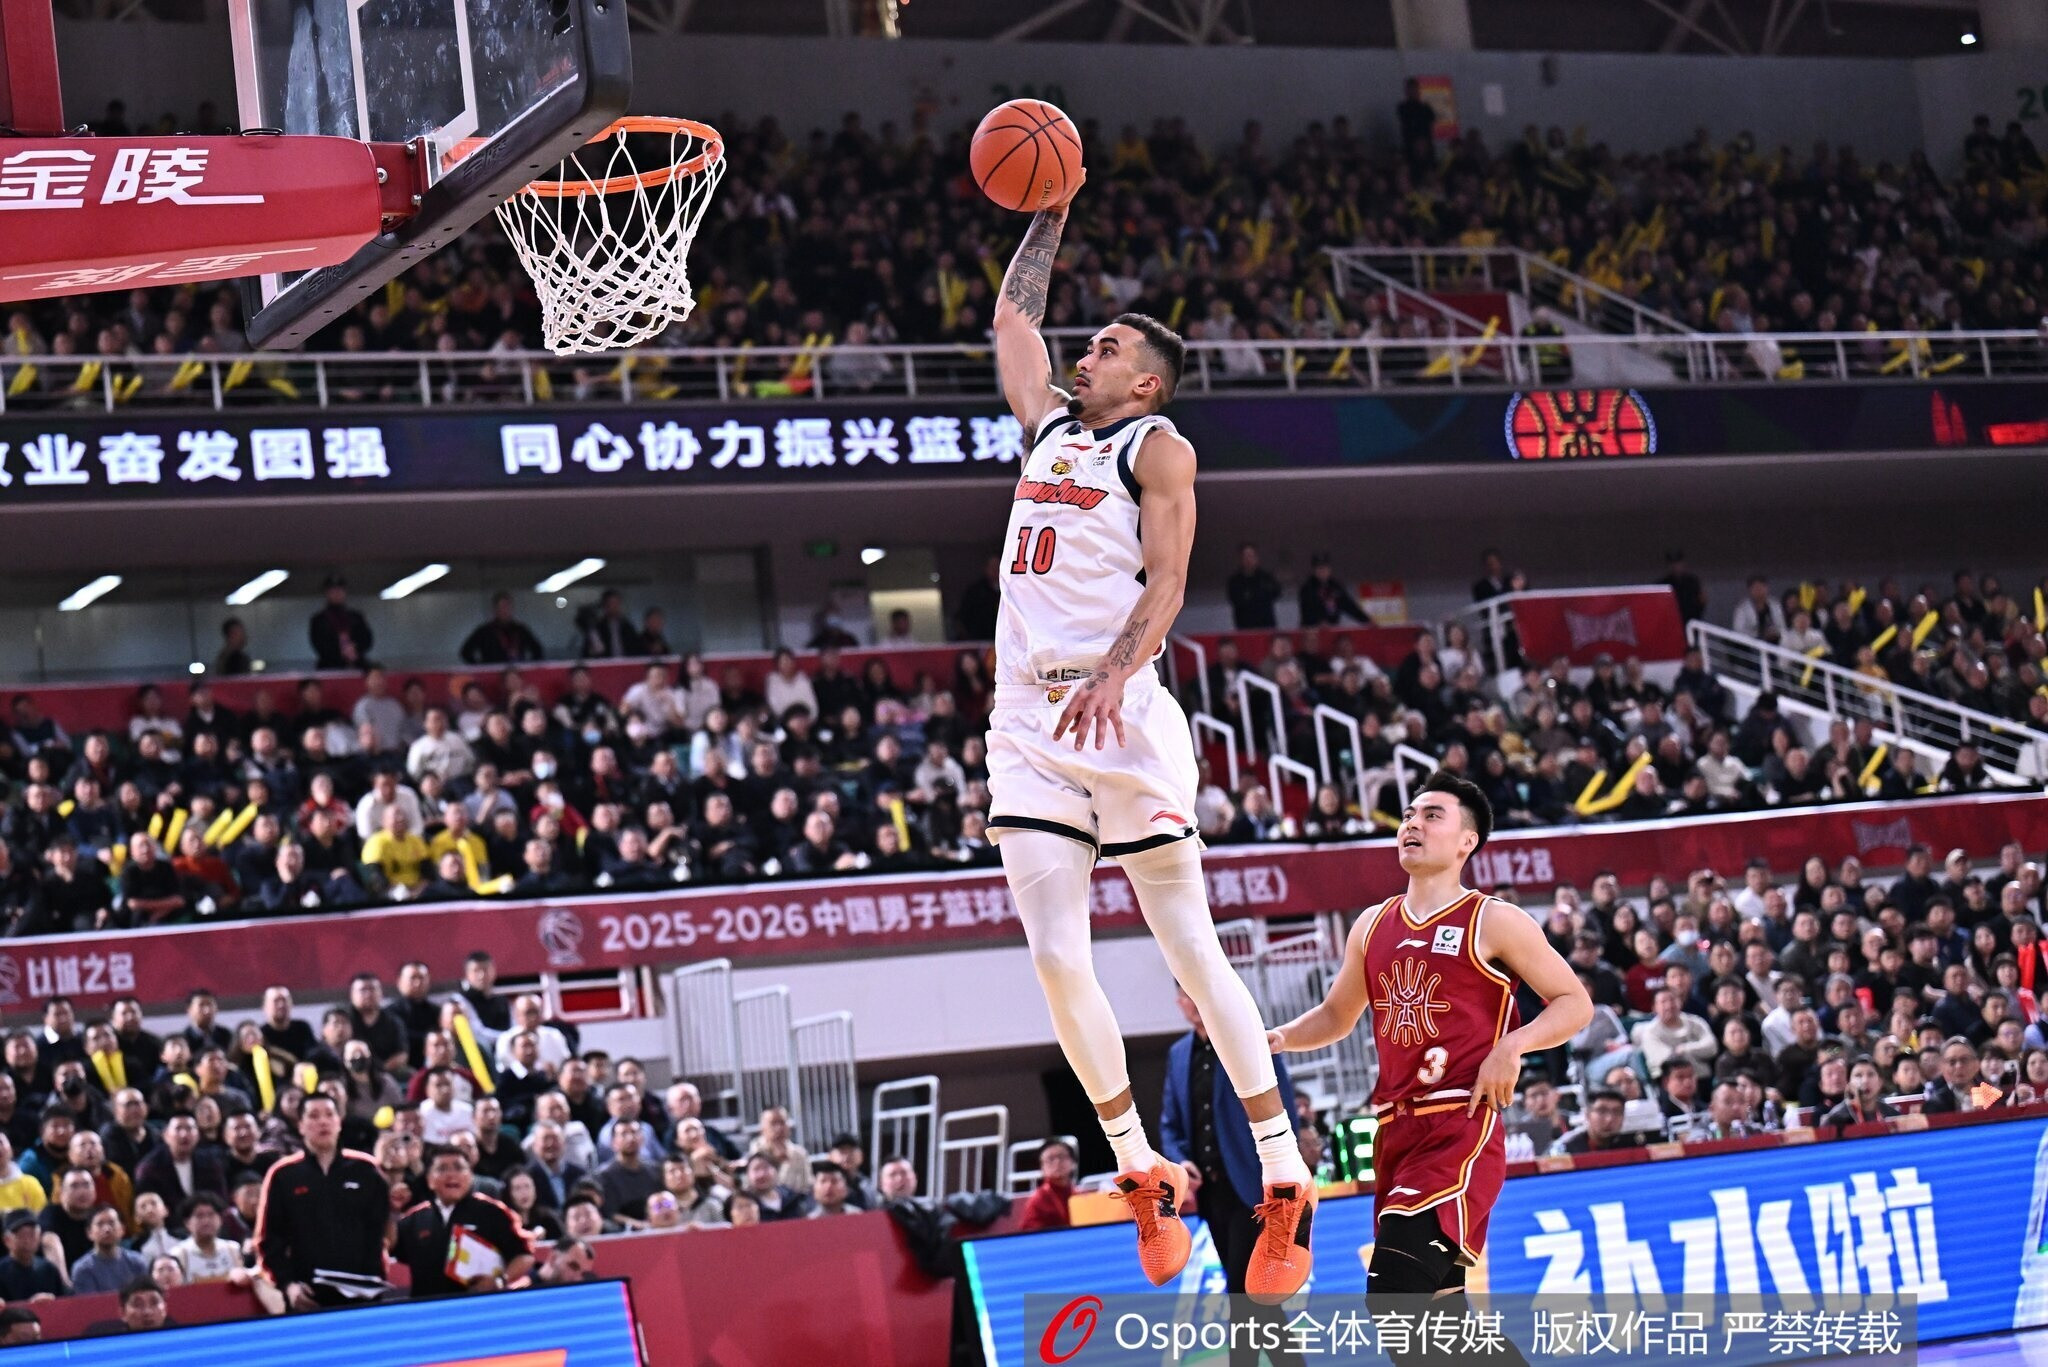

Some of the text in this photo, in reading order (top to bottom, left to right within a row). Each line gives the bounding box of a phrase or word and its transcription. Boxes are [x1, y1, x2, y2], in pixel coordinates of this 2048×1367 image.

[0, 147, 264, 210] 金陵
[500, 416, 1022, 475] 同心协力振兴篮球
[1010, 526, 1056, 575] 10
[1416, 1046, 1449, 1086] 3
[1523, 1167, 1949, 1357] 补水啦
